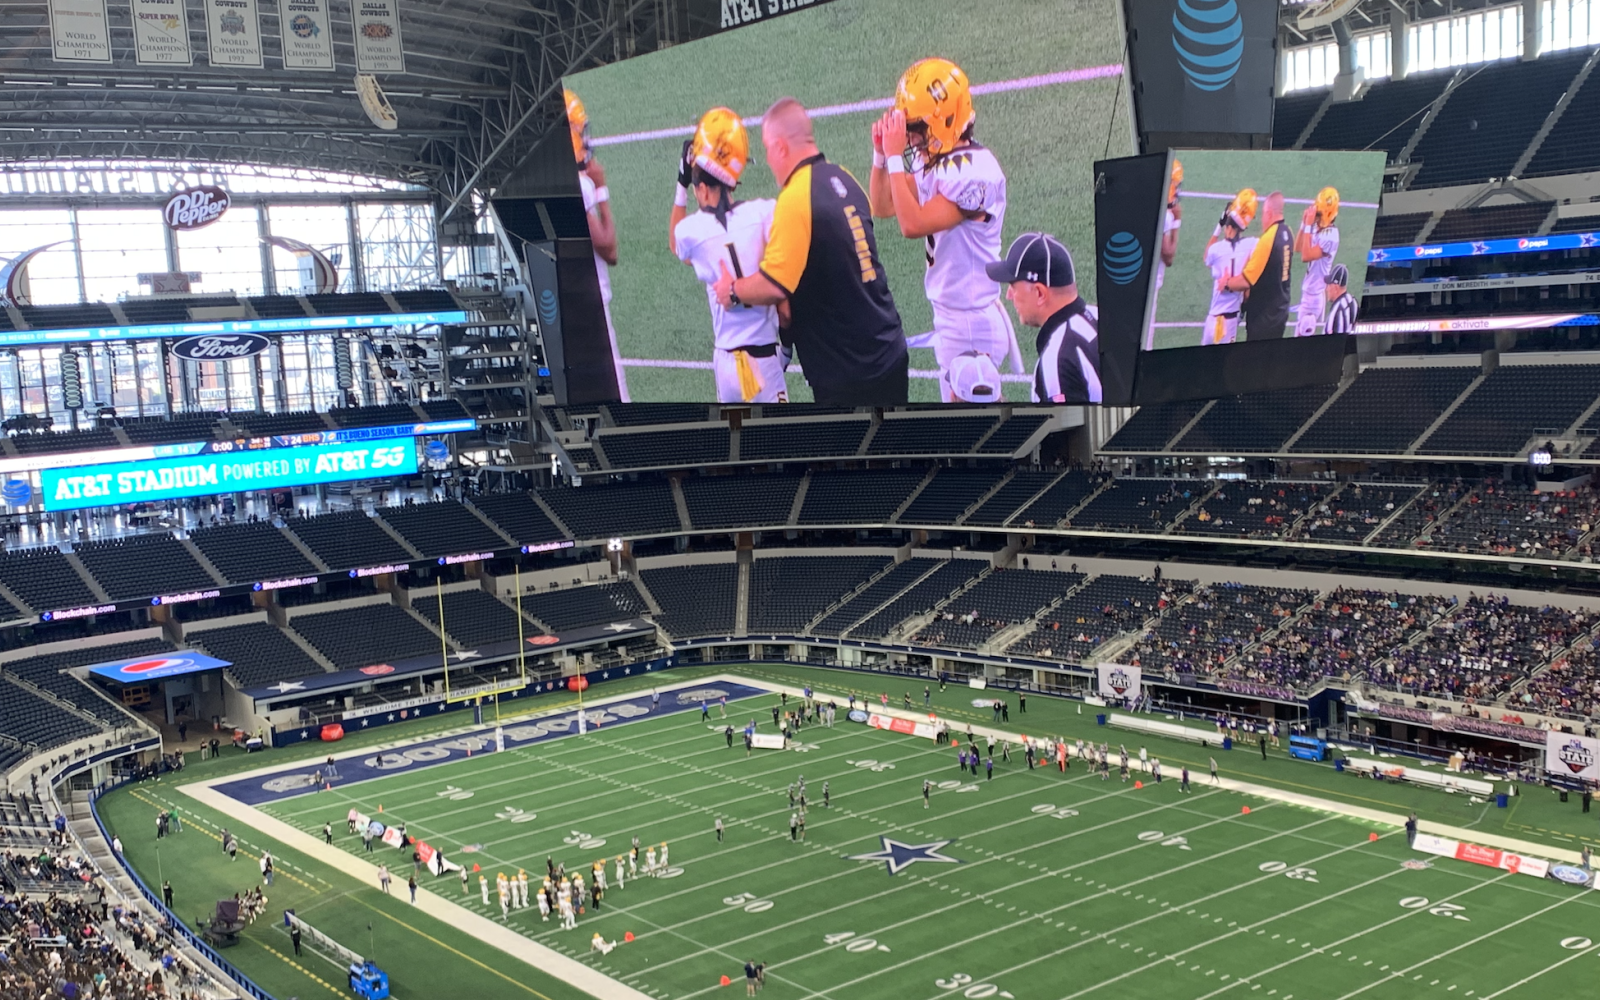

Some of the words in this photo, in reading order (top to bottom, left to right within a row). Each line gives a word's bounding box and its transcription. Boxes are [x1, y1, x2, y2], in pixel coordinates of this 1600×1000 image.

[720, 0, 763, 28] AT&T
[65, 31, 96, 40] WORLD
[146, 35, 177, 44] WORLD
[220, 37, 248, 46] WORLD
[56, 40, 106, 50] CHAMPIONS
[139, 44, 187, 52] CHAMPIONS
[213, 46, 258, 54] CHAMPIONS
[294, 41, 321, 49] WORLD
[73, 50, 92, 58] 1971
[287, 50, 329, 58] CHAMPIONS
[191, 190, 214, 208] Dr
[171, 195, 227, 226] Pepper
[1425, 247, 1442, 256] pepsi
[1529, 239, 1548, 249] pepsi
[1376, 322, 1429, 332] CHAMPIONSHIPS
[1452, 320, 1489, 329] aktivate
[190, 337, 253, 357] Ford
[212, 442, 233, 452] 0:00
[291, 436, 302, 445] 24
[303, 434, 320, 443] BHS
[55, 473, 112, 500] AT&T
[117, 463, 219, 495] STADIUM
[223, 459, 290, 481] POWERED
[294, 457, 310, 473] BY
[315, 450, 370, 474] AT&T
[371, 446, 405, 468] 5G
[528, 539, 574, 553] Blockchain.com
[445, 551, 494, 565] Blockchain.com
[357, 562, 409, 577] Blockchain.com
[262, 575, 318, 591] Blockchain.com
[161, 589, 220, 605] Blockchain.com
[53, 604, 116, 620] Blockchain.com
[363, 702, 402, 715] WELCOME
[419, 697, 431, 705] THE
[364, 703, 650, 770] COWBOYS
[1559, 750, 1594, 765] STATE
[855, 759, 896, 772] 30
[436, 785, 475, 800] 10
[937, 780, 980, 793] 40
[494, 805, 538, 824] 20
[1031, 803, 1080, 820] 50
[563, 830, 607, 850] 30
[1137, 830, 1189, 847] 40
[1258, 861, 1318, 882] 30
[1559, 867, 1582, 881] Ford
[722, 892, 775, 914] 50
[1399, 896, 1467, 917] 20
[823, 931, 878, 953] 40
[935, 973, 999, 1000] 30
